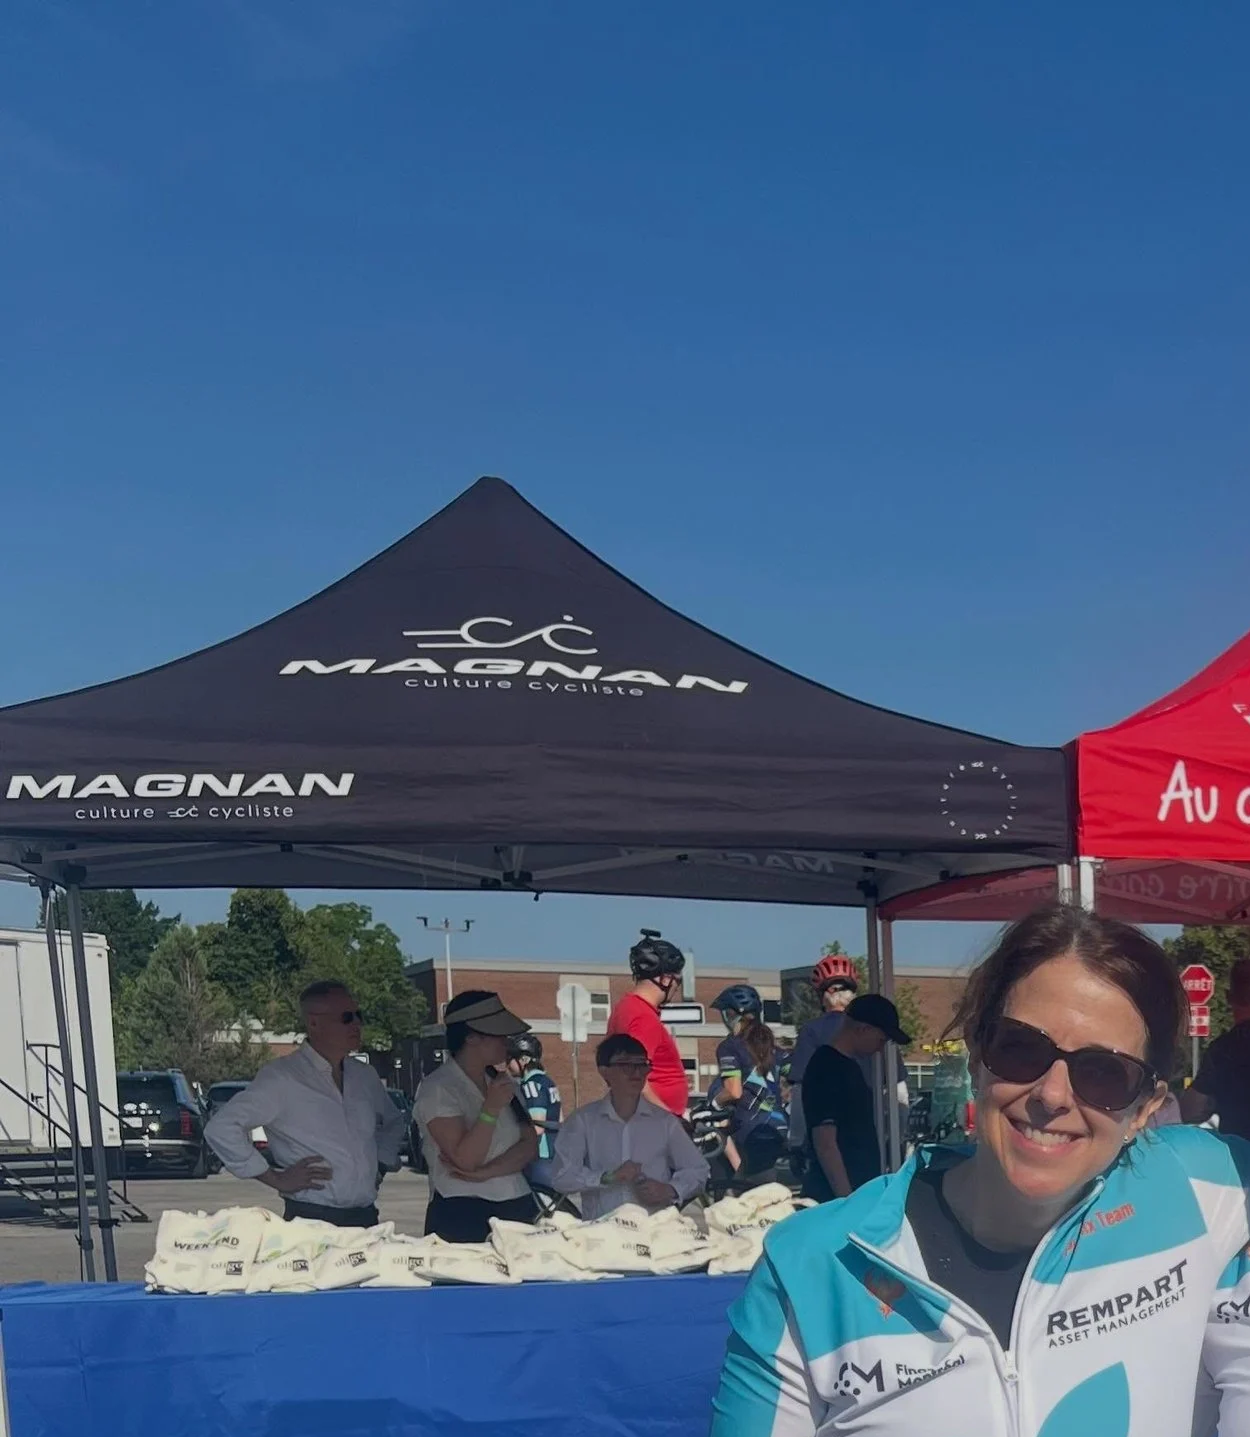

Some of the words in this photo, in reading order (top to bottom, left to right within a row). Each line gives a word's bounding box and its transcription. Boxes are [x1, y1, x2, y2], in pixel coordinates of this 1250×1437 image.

[278, 658, 749, 694] MAGNAN
[404, 677, 512, 690] culture
[529, 679, 644, 697] cycliste
[6, 773, 355, 799] MAGNAN
[1157, 760, 1219, 823] Au
[75, 806, 155, 820] culture
[208, 804, 294, 820] cycliste
[1095, 1202, 1136, 1228] Team
[1047, 1258, 1188, 1336] REMPART
[1049, 1329, 1090, 1349] ASSET
[1097, 1286, 1187, 1336] MANAGEMENT
